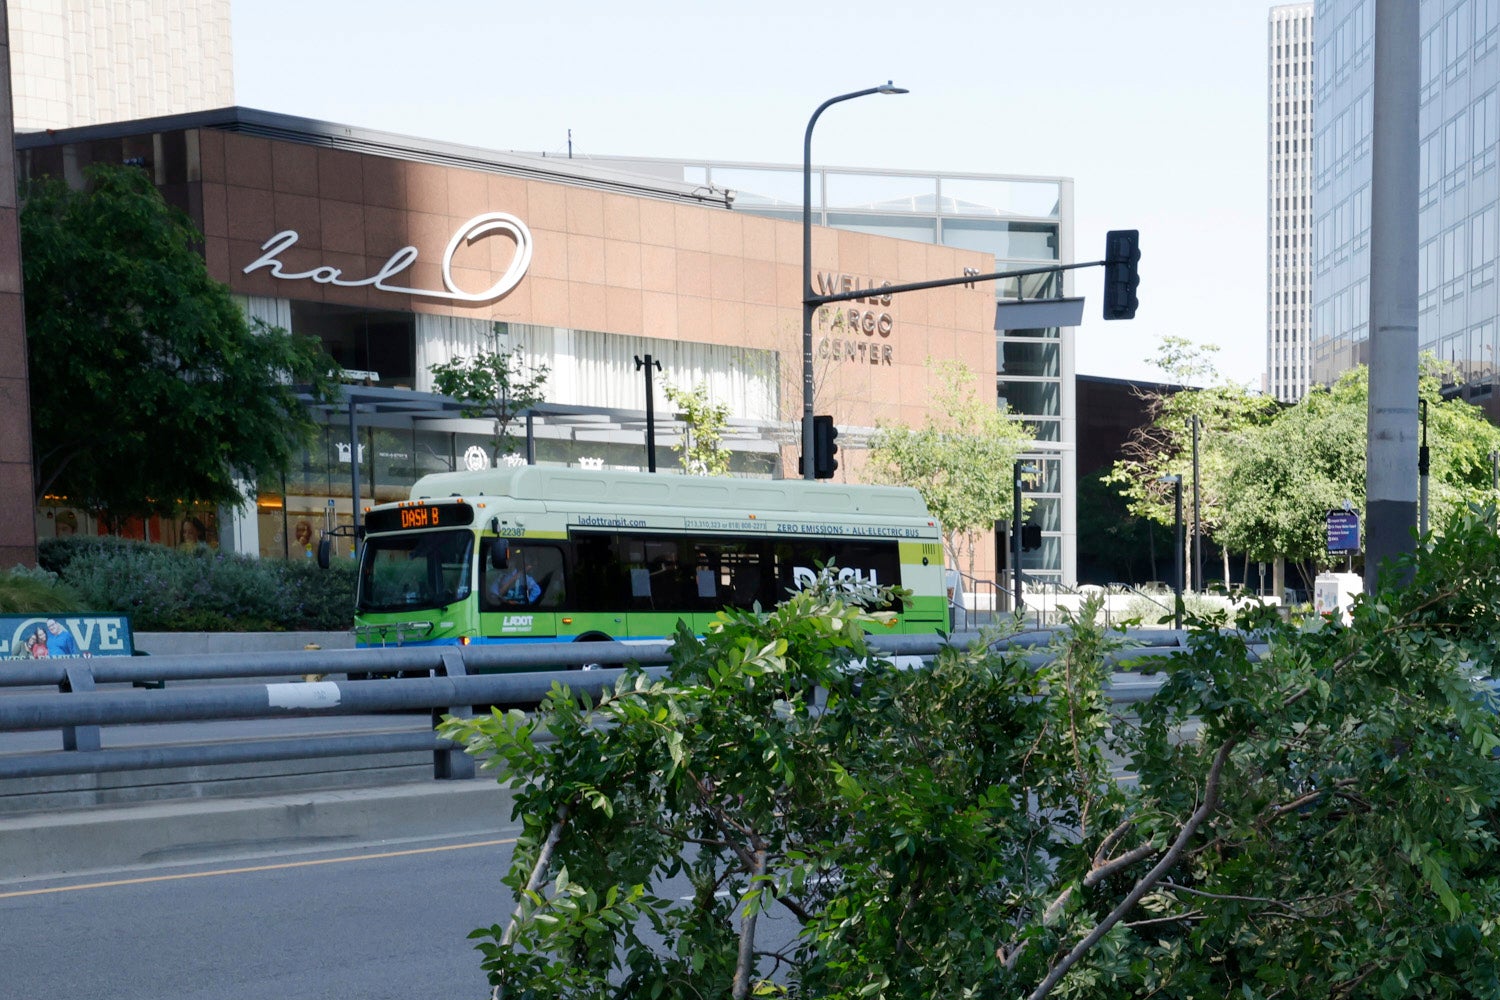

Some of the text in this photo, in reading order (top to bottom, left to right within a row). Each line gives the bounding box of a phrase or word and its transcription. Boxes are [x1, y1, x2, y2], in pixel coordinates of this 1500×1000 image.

[817, 271, 893, 304] WELLS
[818, 305, 893, 335] FARGO
[818, 336, 893, 365] CENTER
[402, 507, 439, 528] DASH B
[578, 515, 646, 527] ladottransit.com
[502, 528, 526, 537] 22387
[776, 523, 919, 537] ZERO EMISSIONS ALL-ELECTRIC BUS
[502, 615, 534, 625] LADOT
